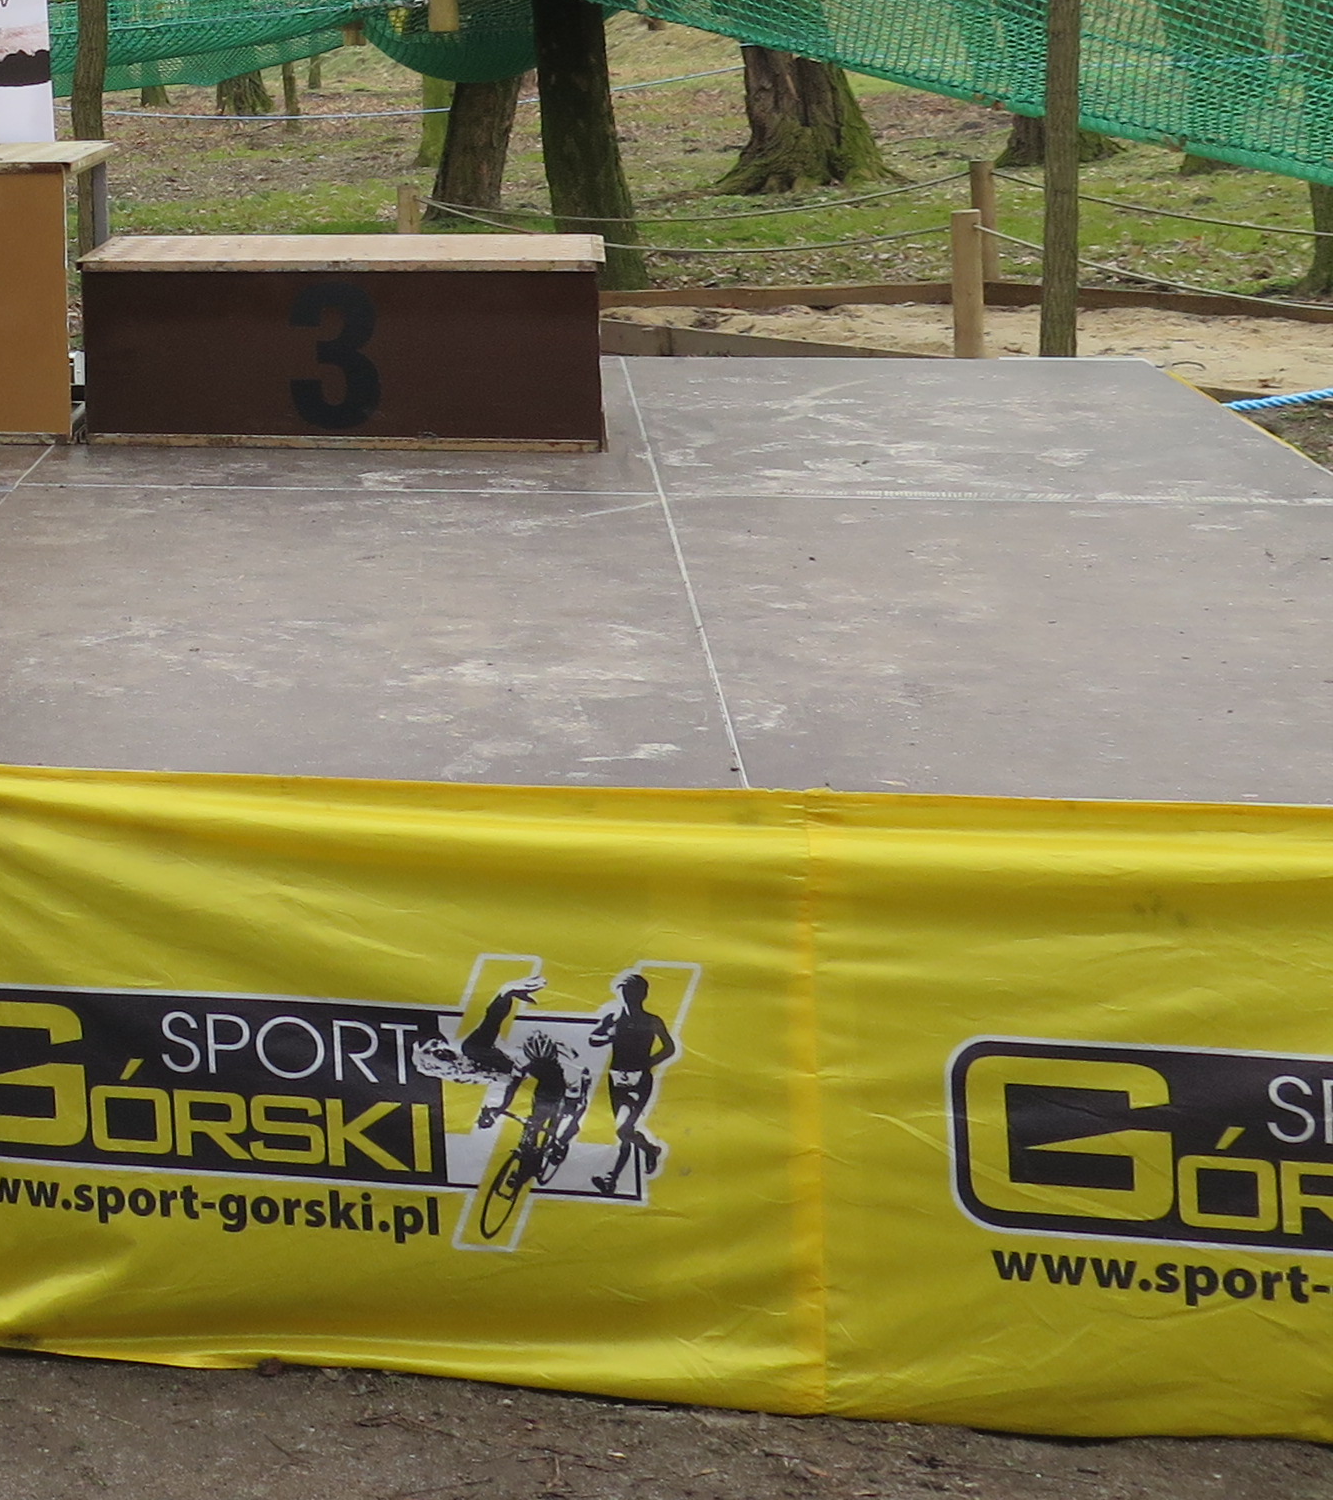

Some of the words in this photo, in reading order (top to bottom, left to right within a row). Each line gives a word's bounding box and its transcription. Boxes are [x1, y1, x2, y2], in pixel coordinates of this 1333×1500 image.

[287, 280, 383, 431] 3
[160, 1009, 419, 1087] SPORT
[1266, 1074, 1333, 1145] S
